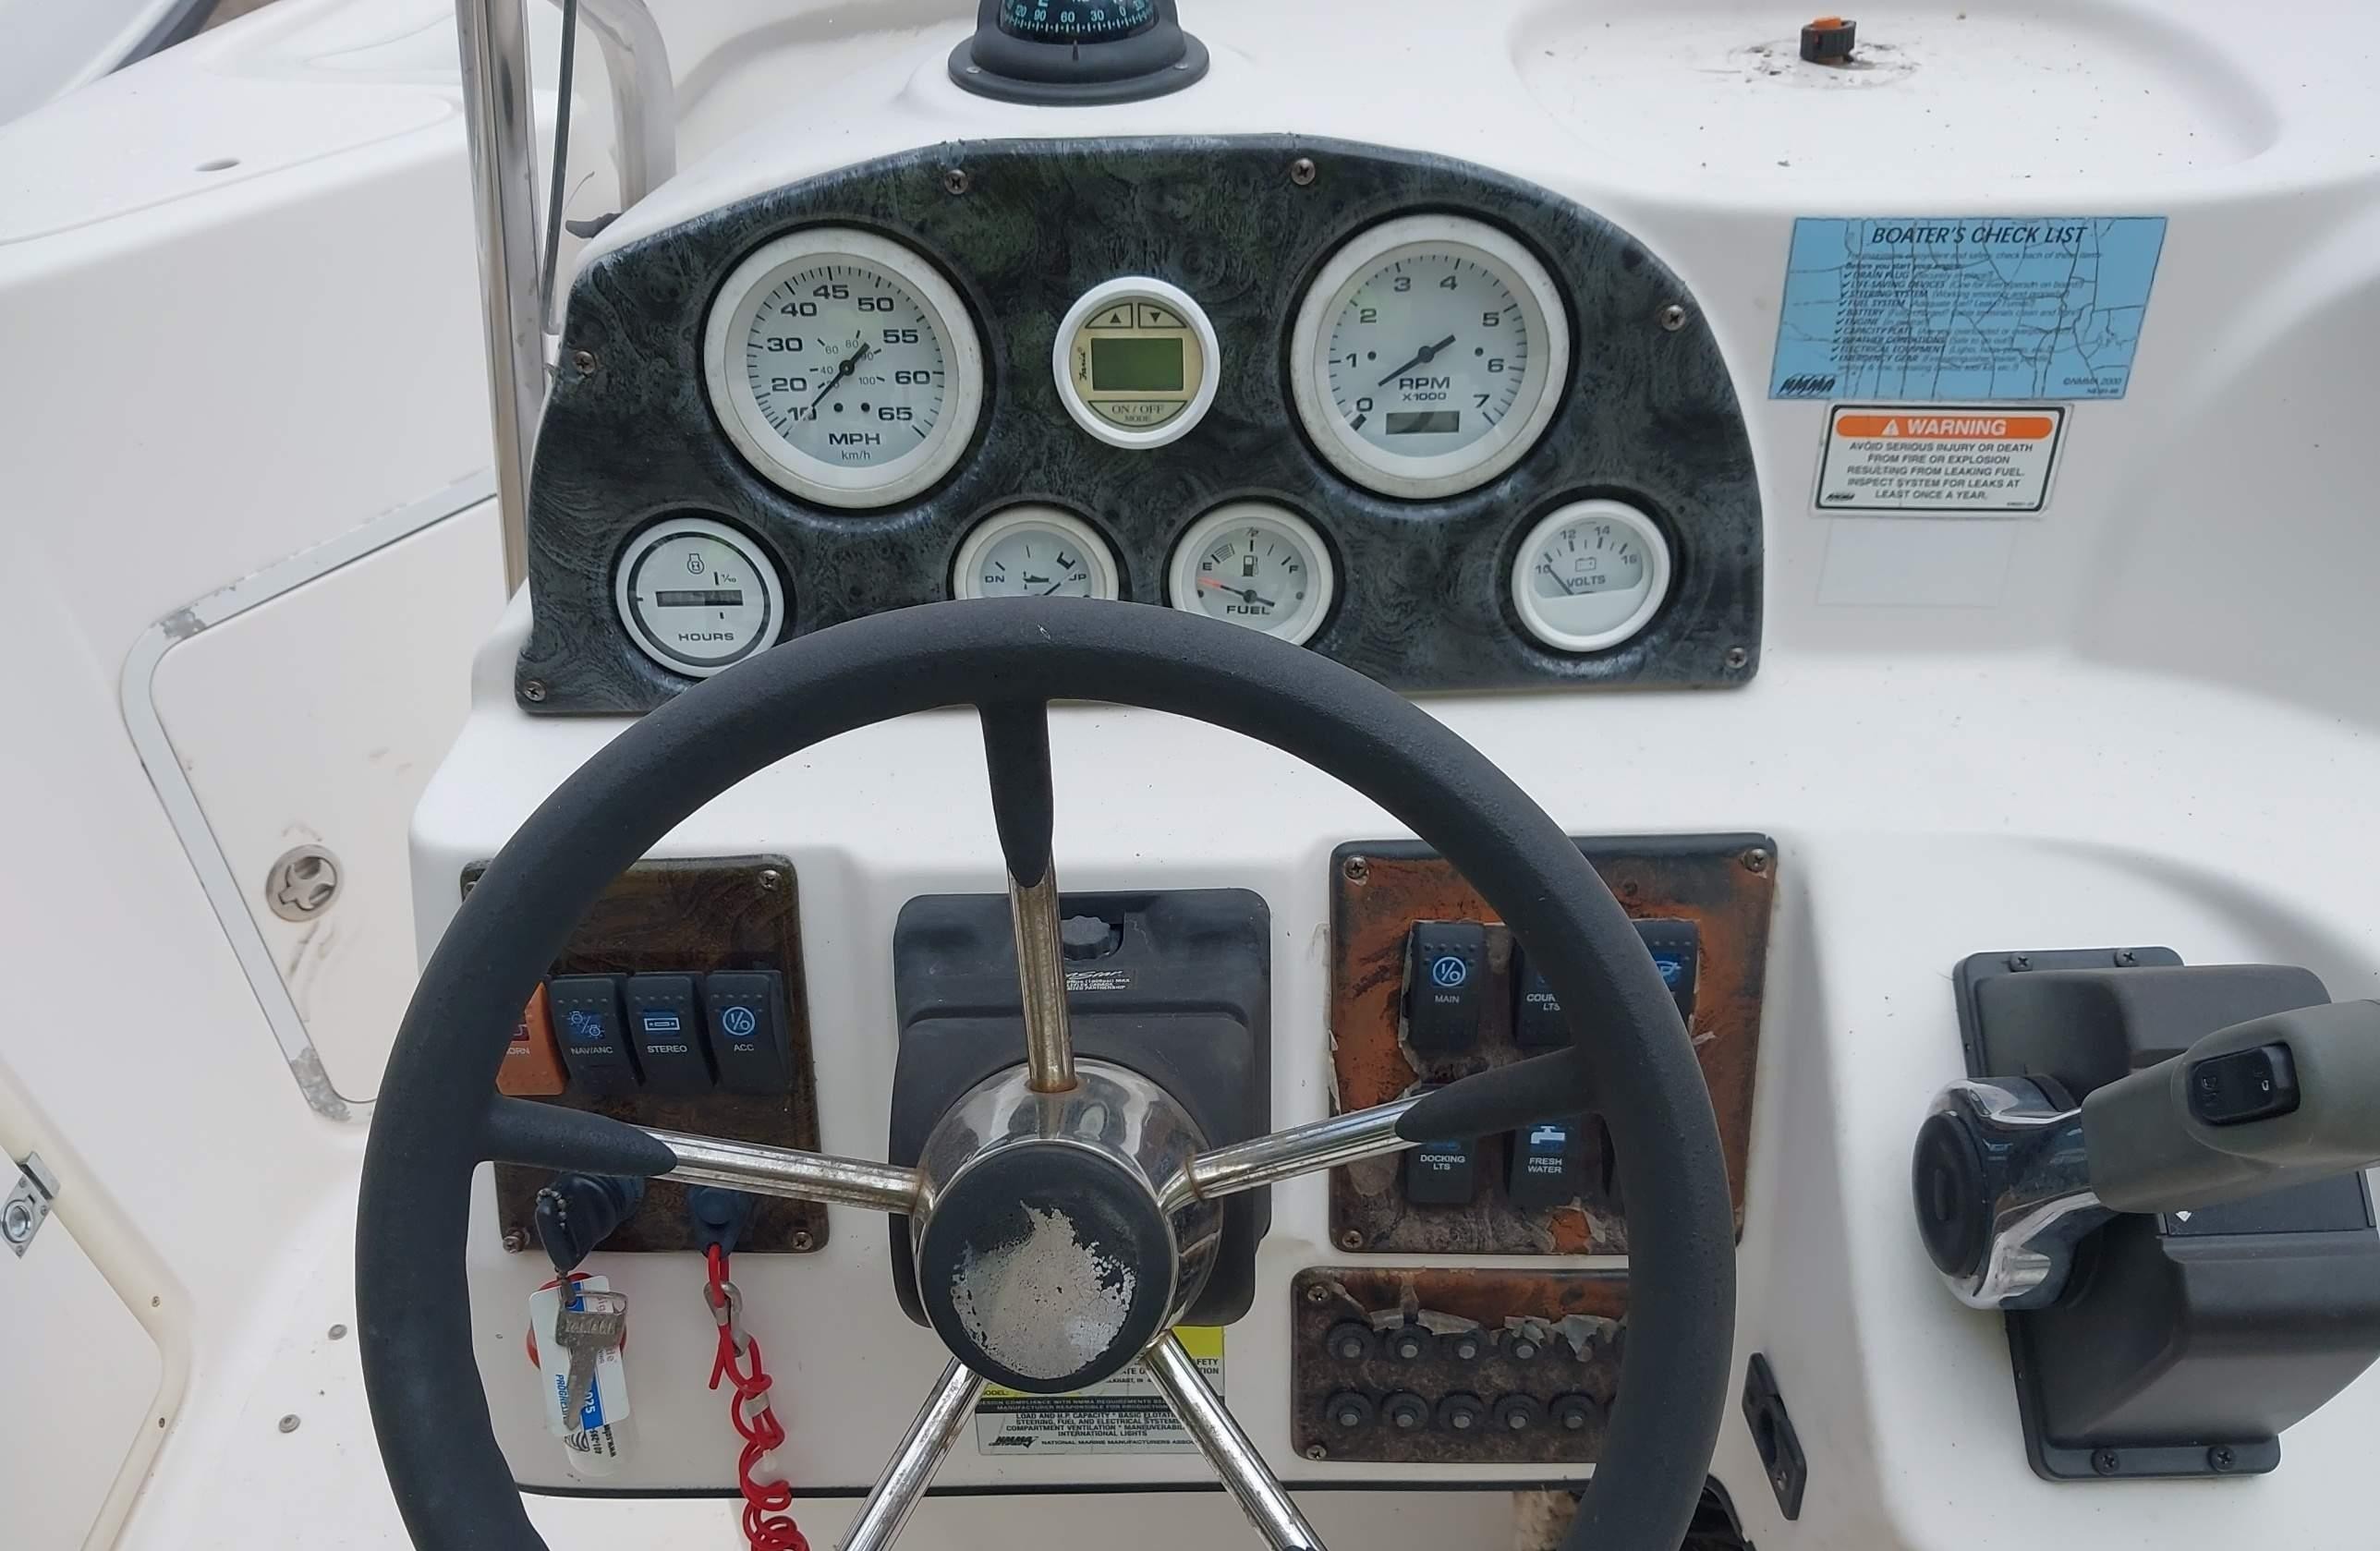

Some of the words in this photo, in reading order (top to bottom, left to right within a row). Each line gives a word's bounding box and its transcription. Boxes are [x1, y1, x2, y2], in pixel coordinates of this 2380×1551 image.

[1034, 9, 1047, 22] 90
[1060, 11, 1075, 23] 60
[1090, 10, 1105, 22] 30
[1119, 6, 1127, 17] 0
[1871, 226, 1966, 244] BOATER'S
[1971, 226, 2041, 244] CHECK
[2044, 226, 2088, 244] LIST
[1393, 277, 1412, 292] 3
[1439, 275, 1458, 291] 4
[812, 284, 850, 300] 45
[780, 301, 818, 318] 40
[857, 297, 894, 313] 50
[1359, 308, 1378, 323] 2
[1482, 312, 1500, 327] 5
[882, 329, 919, 344] 55
[767, 337, 803, 353] 30
[1345, 353, 1357, 368] 1
[1487, 357, 1504, 373] 6
[858, 376, 876, 385] 100
[894, 370, 931, 385] 60
[1399, 376, 1451, 390] RPM
[771, 377, 808, 393] 20
[1402, 392, 1447, 402] X1000
[1473, 394, 1490, 408] 7
[1111, 405, 1130, 415] ON
[1139, 405, 1164, 415] OFF
[1355, 397, 1374, 413] 0
[878, 406, 914, 421] 65
[1907, 419, 2008, 436] WARNING
[828, 432, 881, 445] MPH
[1849, 441, 1884, 452] AVOID
[1885, 442, 1935, 452] SERIOUS
[1936, 442, 1975, 453] INJURY
[1977, 442, 1995, 453] OR
[1996, 442, 2034, 453] DEATH
[841, 450, 871, 461] km/h
[1866, 454, 1900, 464] FROM
[1902, 454, 1927, 464] FIRE
[1928, 454, 1946, 464] OR
[1947, 454, 2010, 465] EXPLOSION
[1847, 466, 1908, 476] RESULTING
[1909, 466, 1942, 476] FROM
[1943, 467, 1993, 477] LEAKING
[1994, 467, 2025, 477] FUEL.
[1847, 478, 1893, 488] INSPECT
[1896, 478, 1941, 488] SYSTEM
[1942, 479, 1966, 489] FOR
[1966, 479, 2004, 489] LEAKS
[2005, 479, 2020, 489] AT
[1875, 490, 1910, 500] LEAST
[1912, 490, 1944, 500] ONCE
[1945, 490, 1953, 500] A
[1560, 528, 1576, 539] 12
[1594, 525, 1610, 536] 14
[1621, 554, 1637, 565] 16
[1202, 562, 1213, 571] E
[1288, 564, 1299, 574] F
[1535, 564, 1550, 575] 10
[984, 575, 1005, 584] DN
[1566, 575, 1607, 588] VOLTS
[1226, 605, 1271, 615] FUEL
[678, 632, 735, 642] HOURS
[1435, 995, 1460, 1004] MAIN
[505, 1047, 530, 1055] ORN
[647, 1044, 688, 1054] STEREO
[733, 1043, 755, 1052] ACC
[1420, 1154, 1465, 1164] DOCKING
[1528, 1157, 1563, 1166] FRESH
[1432, 1162, 1451, 1171] LTS
[1526, 1165, 1562, 1174] WATER
